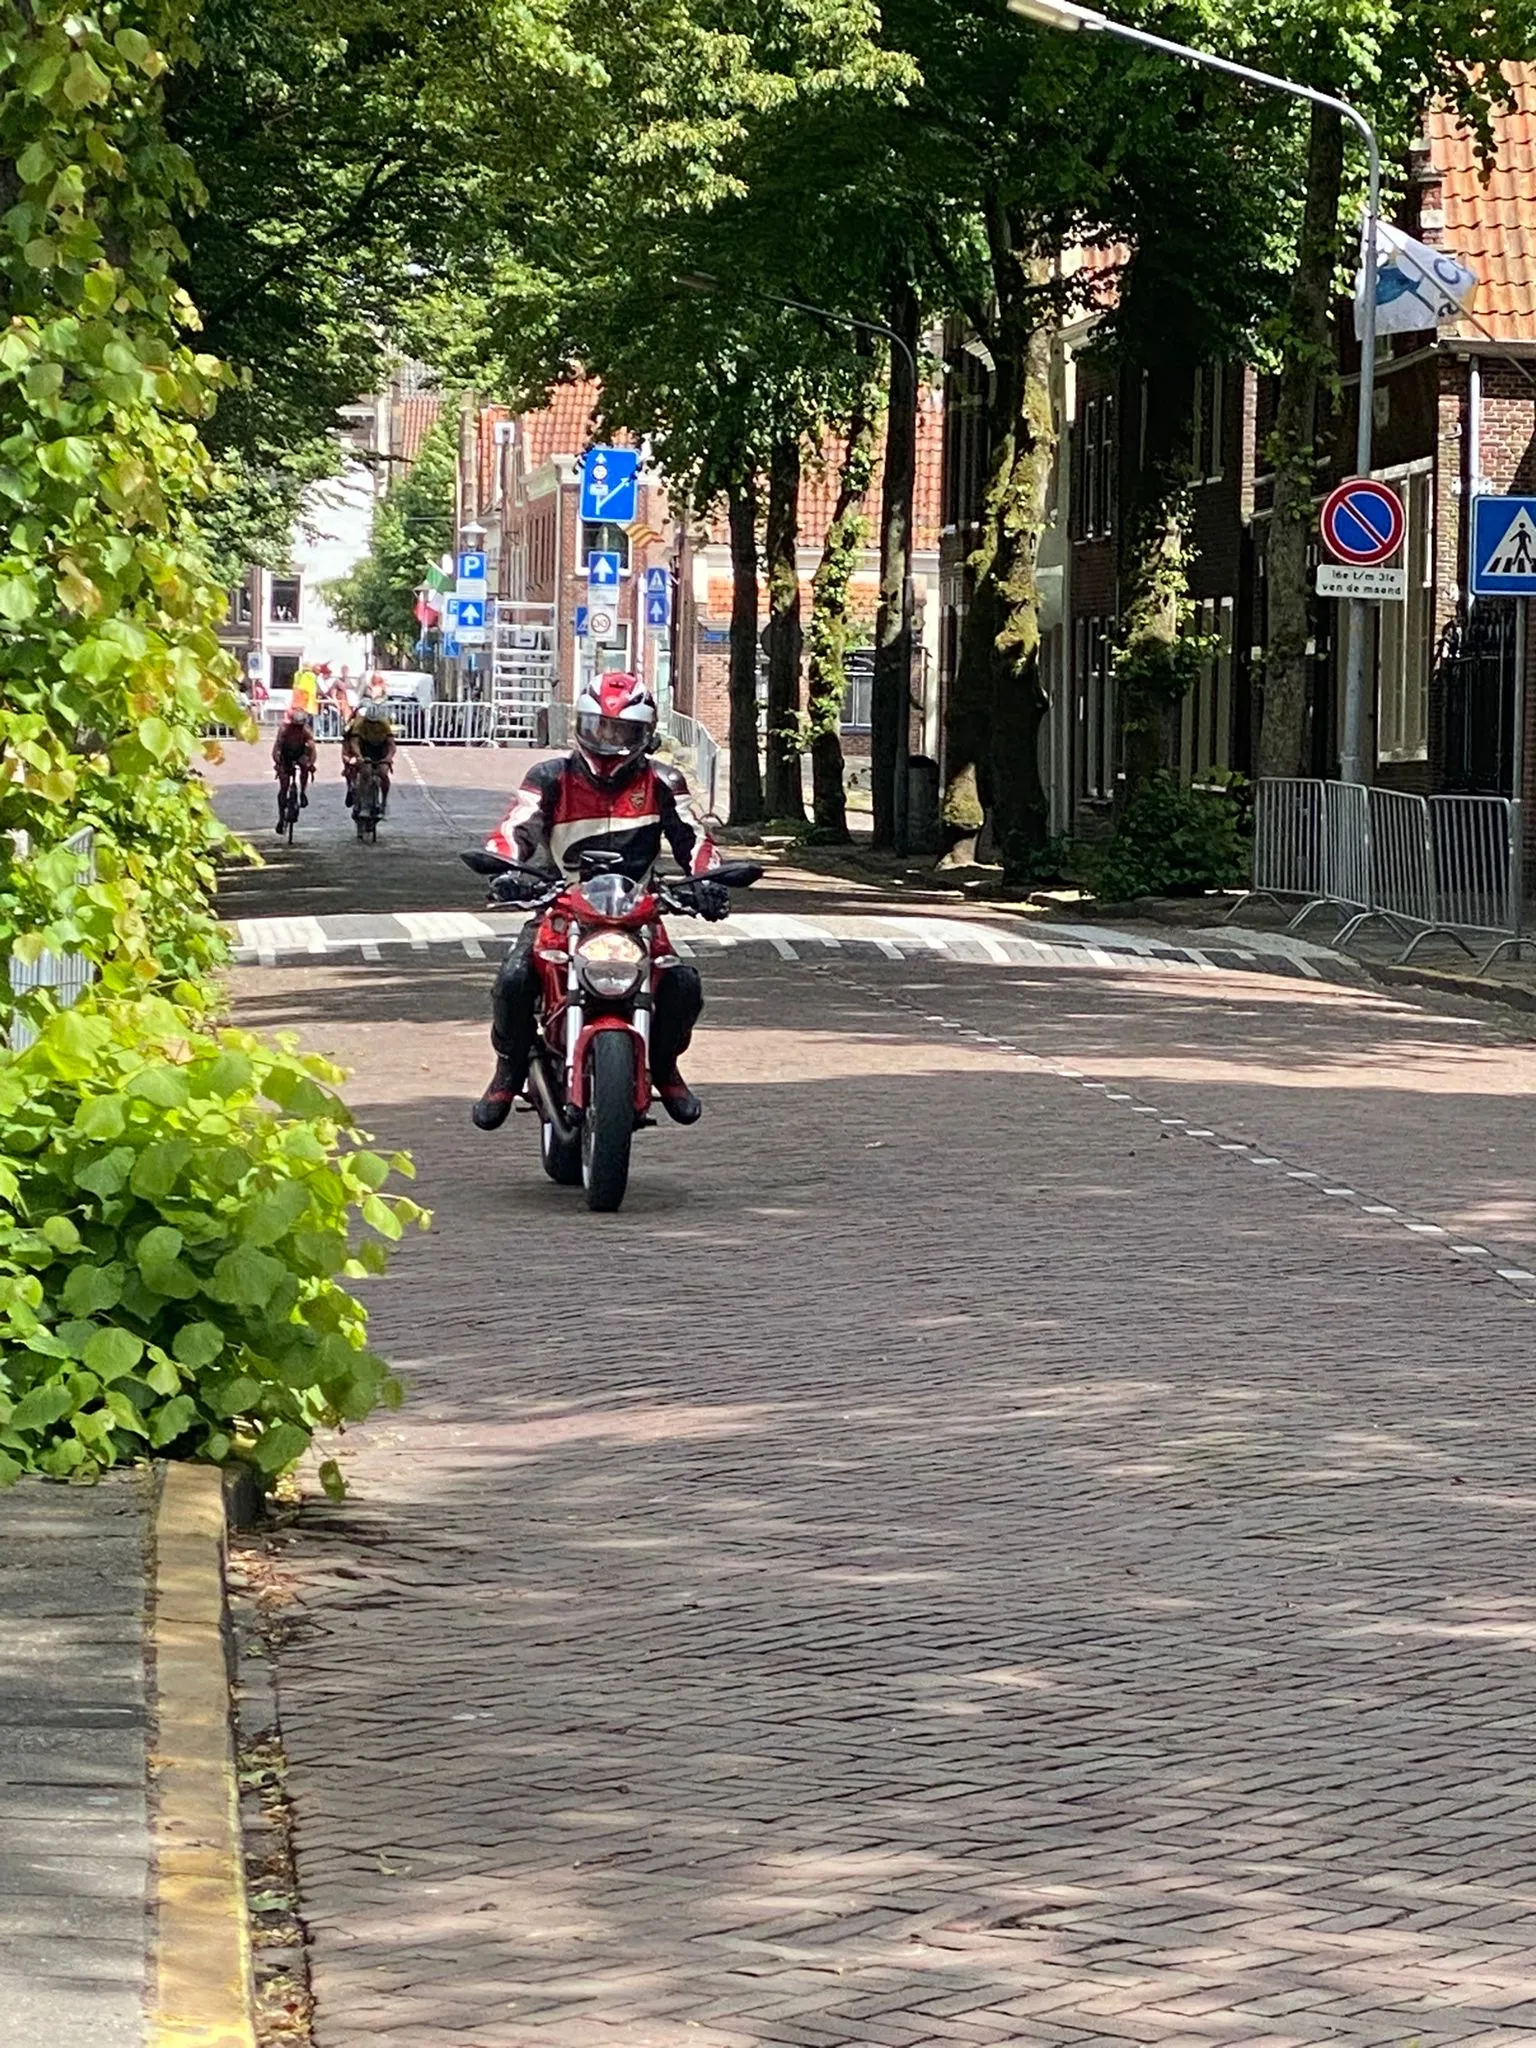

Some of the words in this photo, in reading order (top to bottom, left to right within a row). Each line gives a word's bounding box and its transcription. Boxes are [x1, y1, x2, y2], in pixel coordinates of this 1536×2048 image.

[464, 555, 481, 577] P
[1353, 571, 1375, 581] t/m
[1346, 583, 1360, 593] de
[1364, 585, 1401, 595] maand
